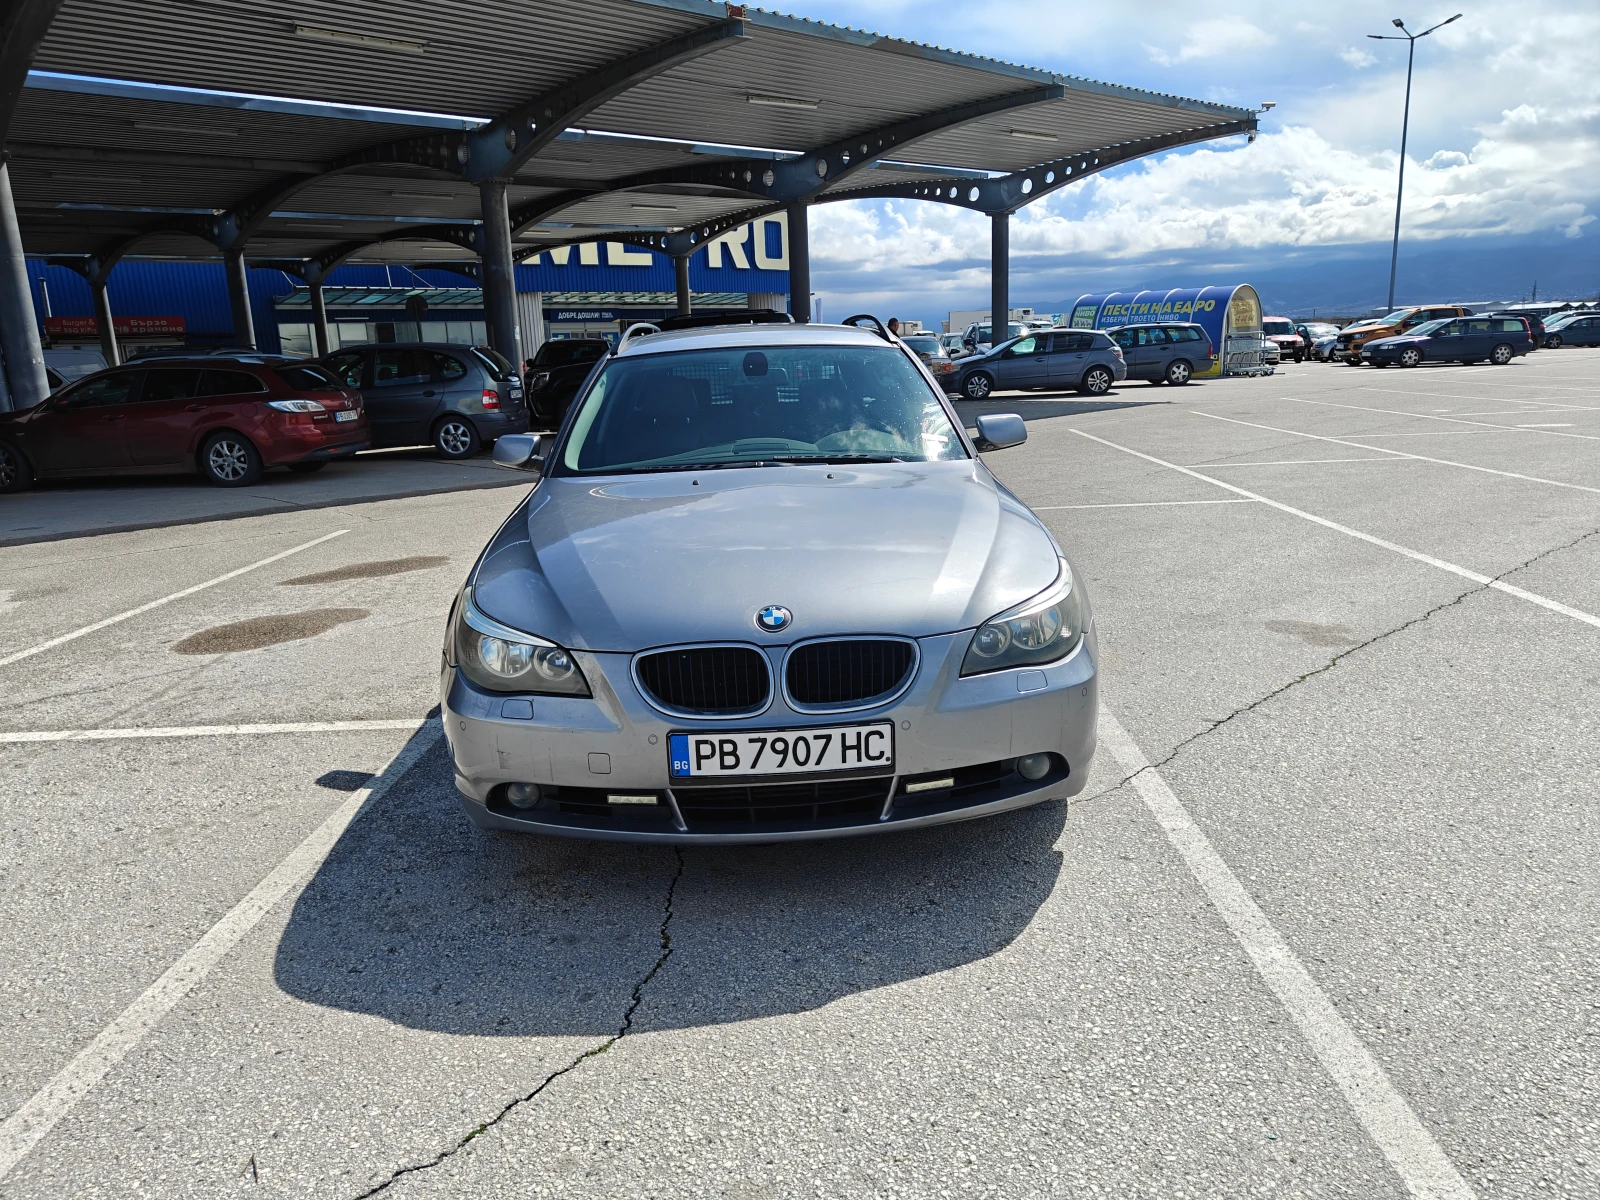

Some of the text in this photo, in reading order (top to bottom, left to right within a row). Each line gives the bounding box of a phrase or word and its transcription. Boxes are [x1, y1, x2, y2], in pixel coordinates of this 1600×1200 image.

[1103, 303, 1149, 315] ПЕСТИ
[1150, 302, 1171, 314] НА
[1173, 300, 1216, 313] ЕДРО
[695, 739, 741, 771] PB
[748, 734, 833, 769] 7907
[674, 761, 689, 771] BG
